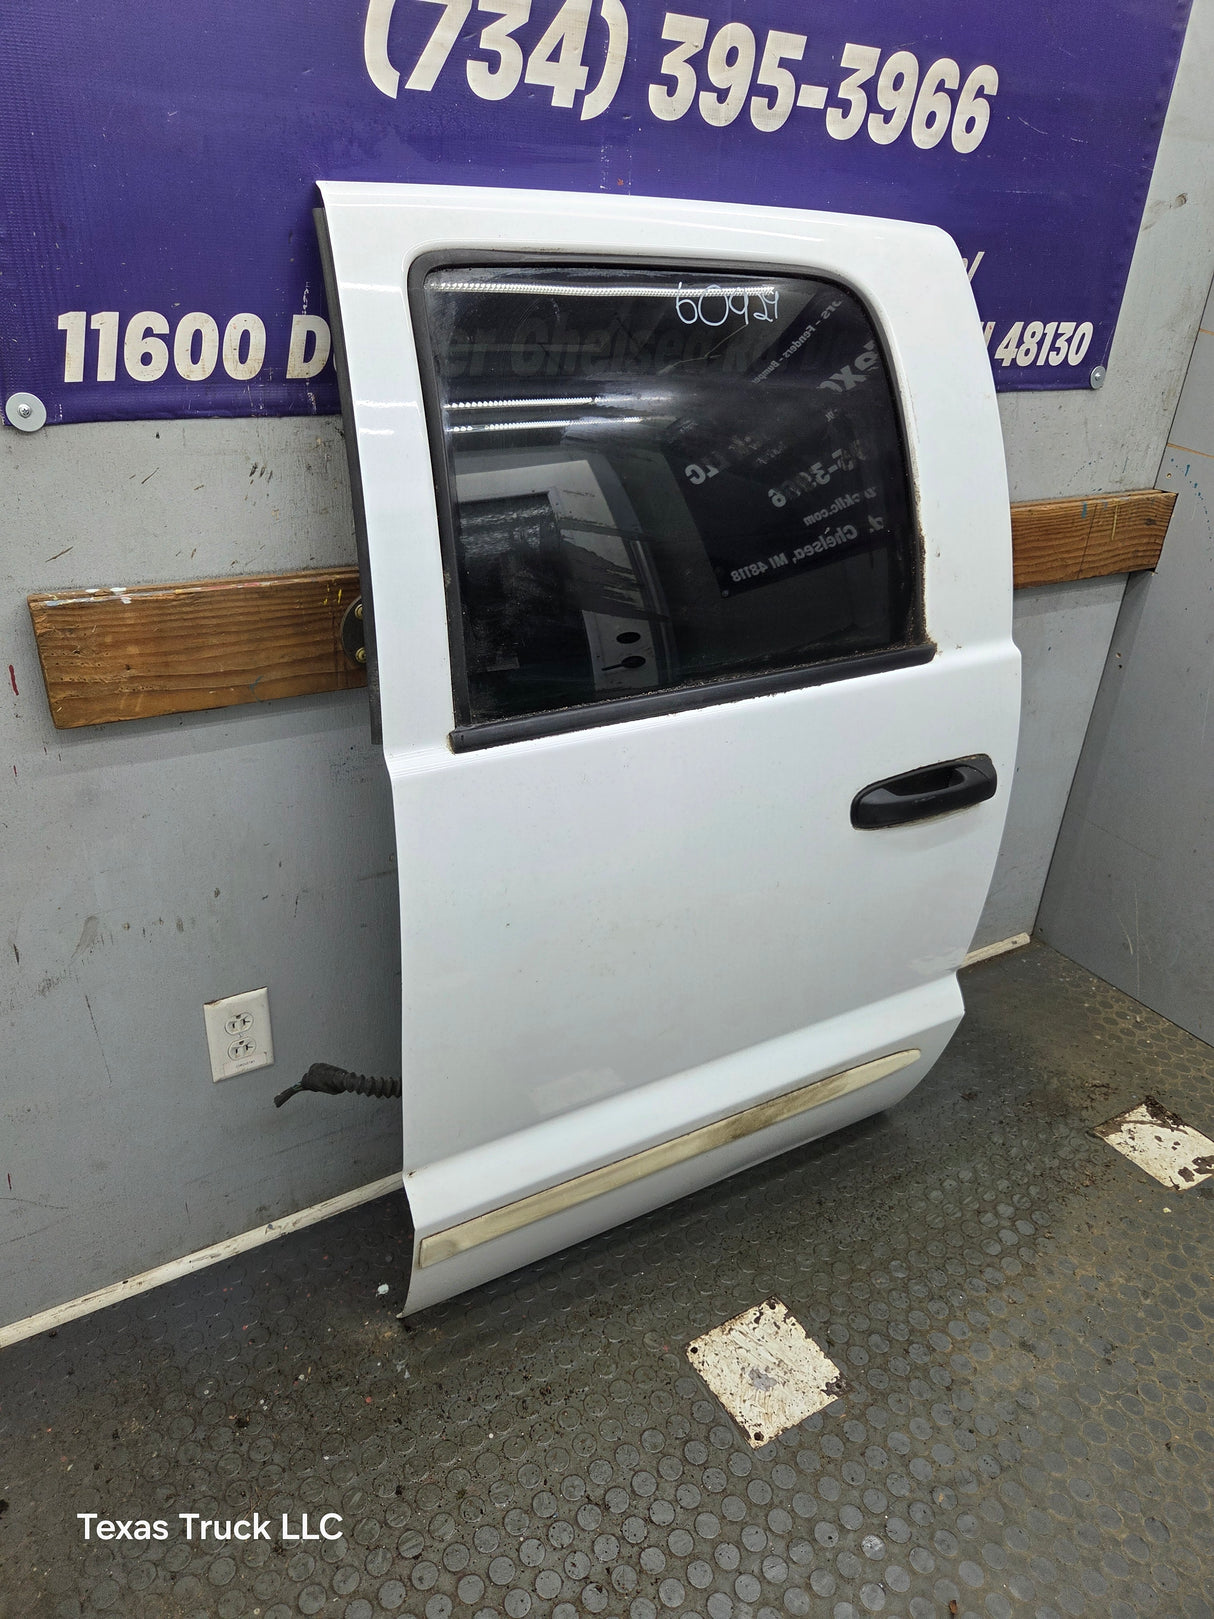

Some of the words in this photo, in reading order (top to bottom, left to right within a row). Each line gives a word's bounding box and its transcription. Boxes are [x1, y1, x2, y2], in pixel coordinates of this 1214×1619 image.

[364, 0, 629, 121] (734)
[648, 12, 999, 154] 395-3966
[57, 310, 267, 383] 11600
[994, 320, 1094, 367] 48130
